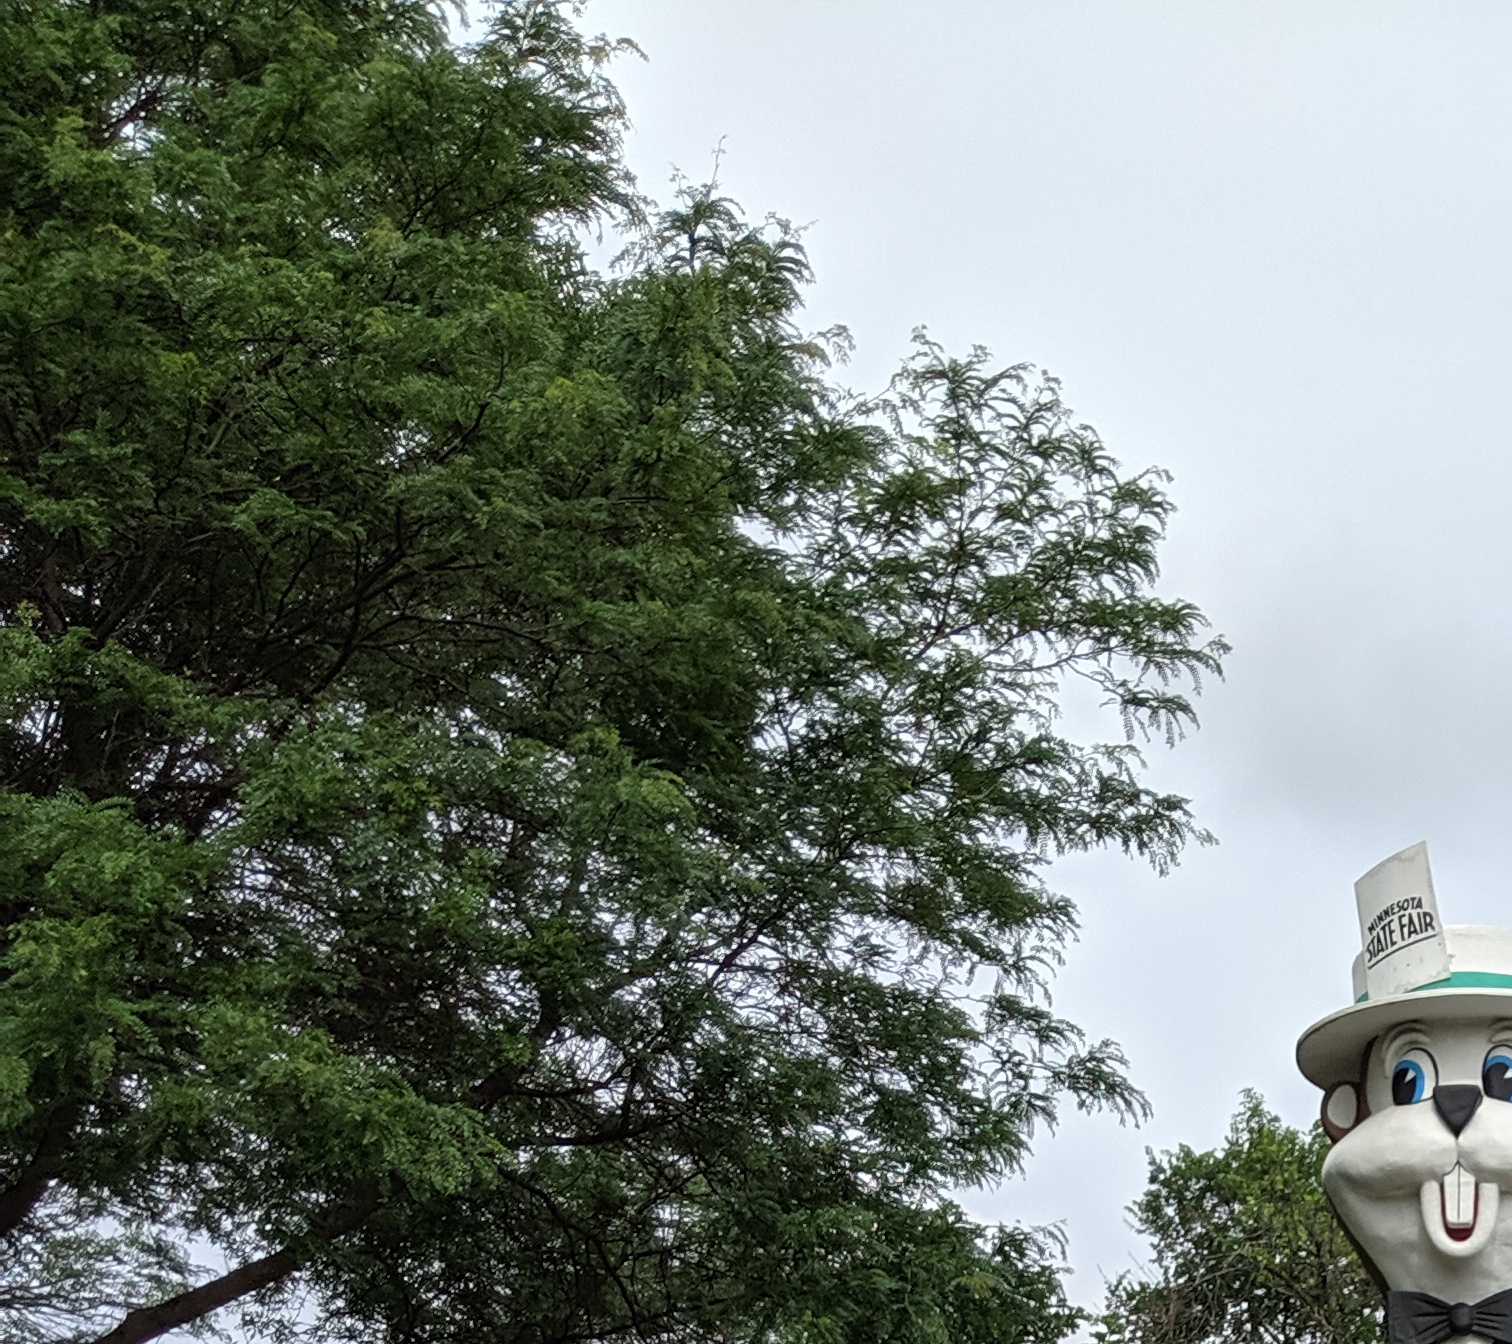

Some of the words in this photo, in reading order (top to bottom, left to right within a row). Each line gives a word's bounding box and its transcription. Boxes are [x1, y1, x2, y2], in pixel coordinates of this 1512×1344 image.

[1365, 918, 1397, 963] STATE
[1398, 911, 1436, 941] FAIR
[1367, 896, 1423, 936] MINNESOTA
